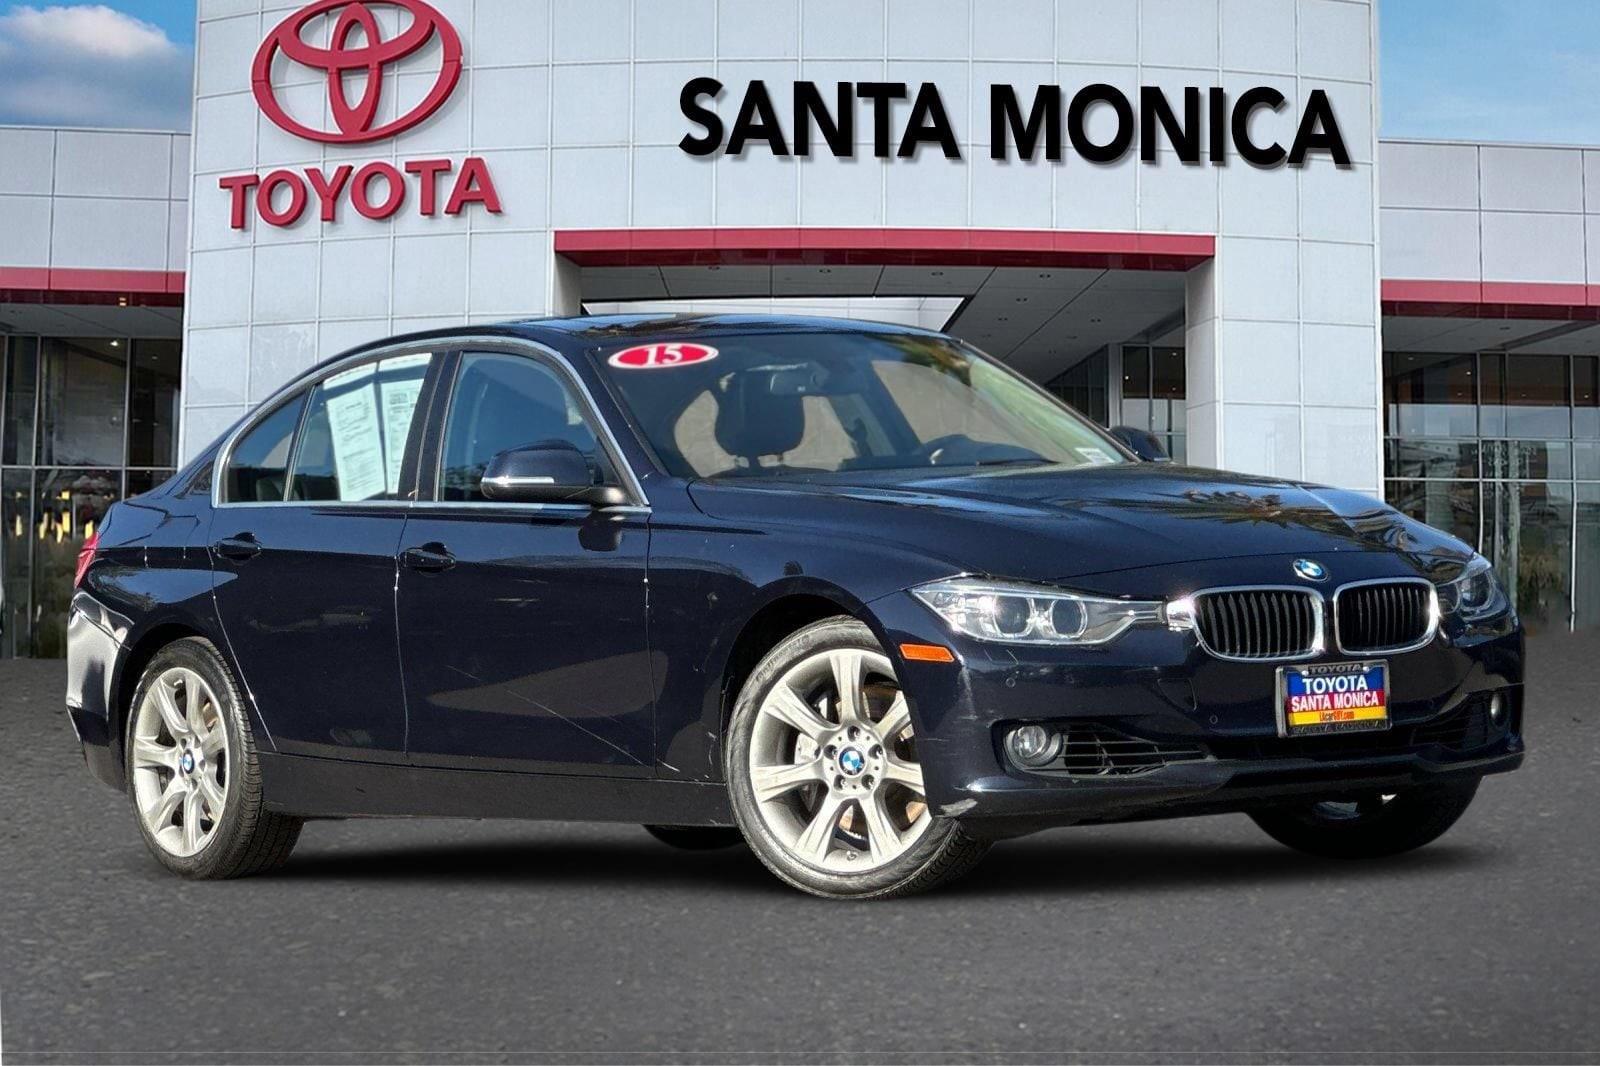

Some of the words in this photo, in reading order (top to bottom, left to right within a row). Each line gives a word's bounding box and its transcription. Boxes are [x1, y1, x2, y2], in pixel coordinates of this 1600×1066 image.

[678, 77, 961, 159] SANTA
[990, 84, 1351, 165] MONICA
[219, 157, 502, 229] TOYOTA
[644, 344, 682, 366] 15
[1309, 663, 1362, 674] TOYOTA
[1302, 675, 1368, 694] TOYOTA
[1291, 695, 1331, 712] SANTA
[1334, 691, 1379, 709] MONICA
